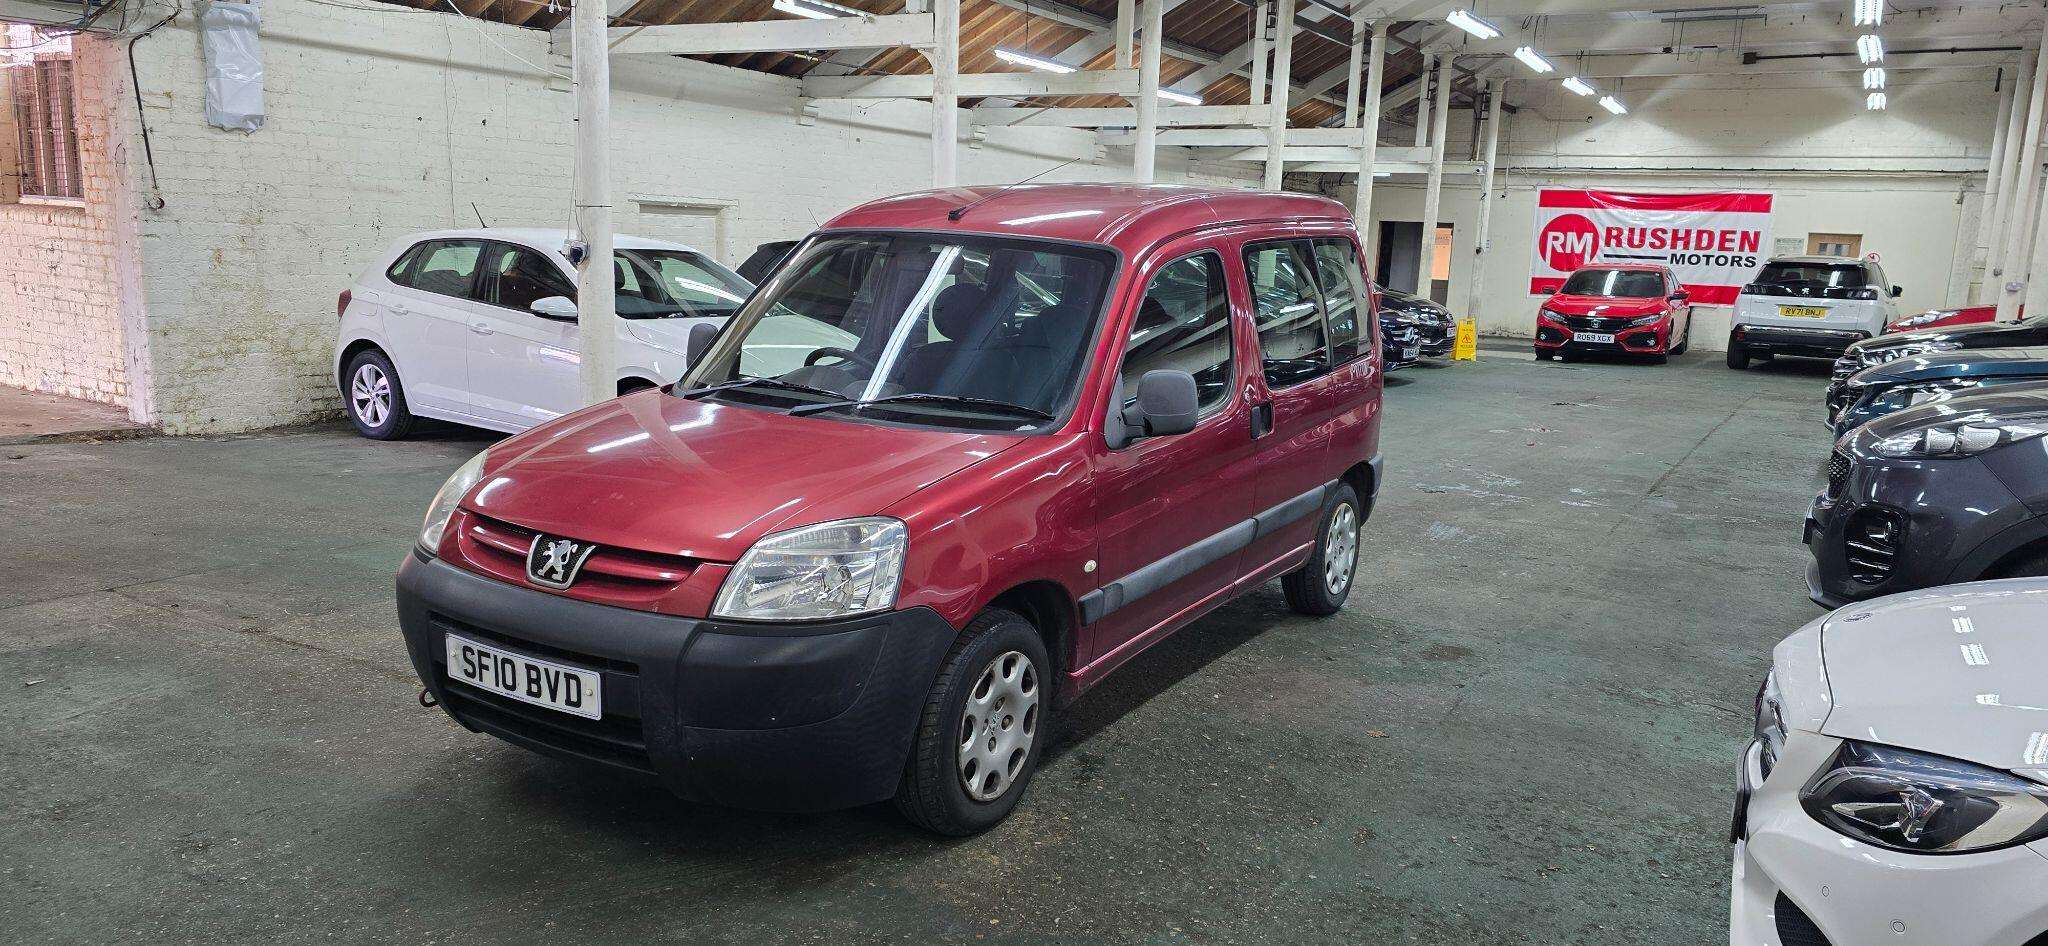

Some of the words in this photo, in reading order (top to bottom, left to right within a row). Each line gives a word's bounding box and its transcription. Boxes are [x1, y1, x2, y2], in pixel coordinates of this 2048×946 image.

[1545, 231, 1594, 265] RM
[1603, 226, 1761, 253] RUSHDEN
[1670, 253, 1757, 268] MOTORS
[1597, 334, 1612, 343] XGX
[462, 645, 517, 692] SF10
[524, 662, 582, 708] BVD
